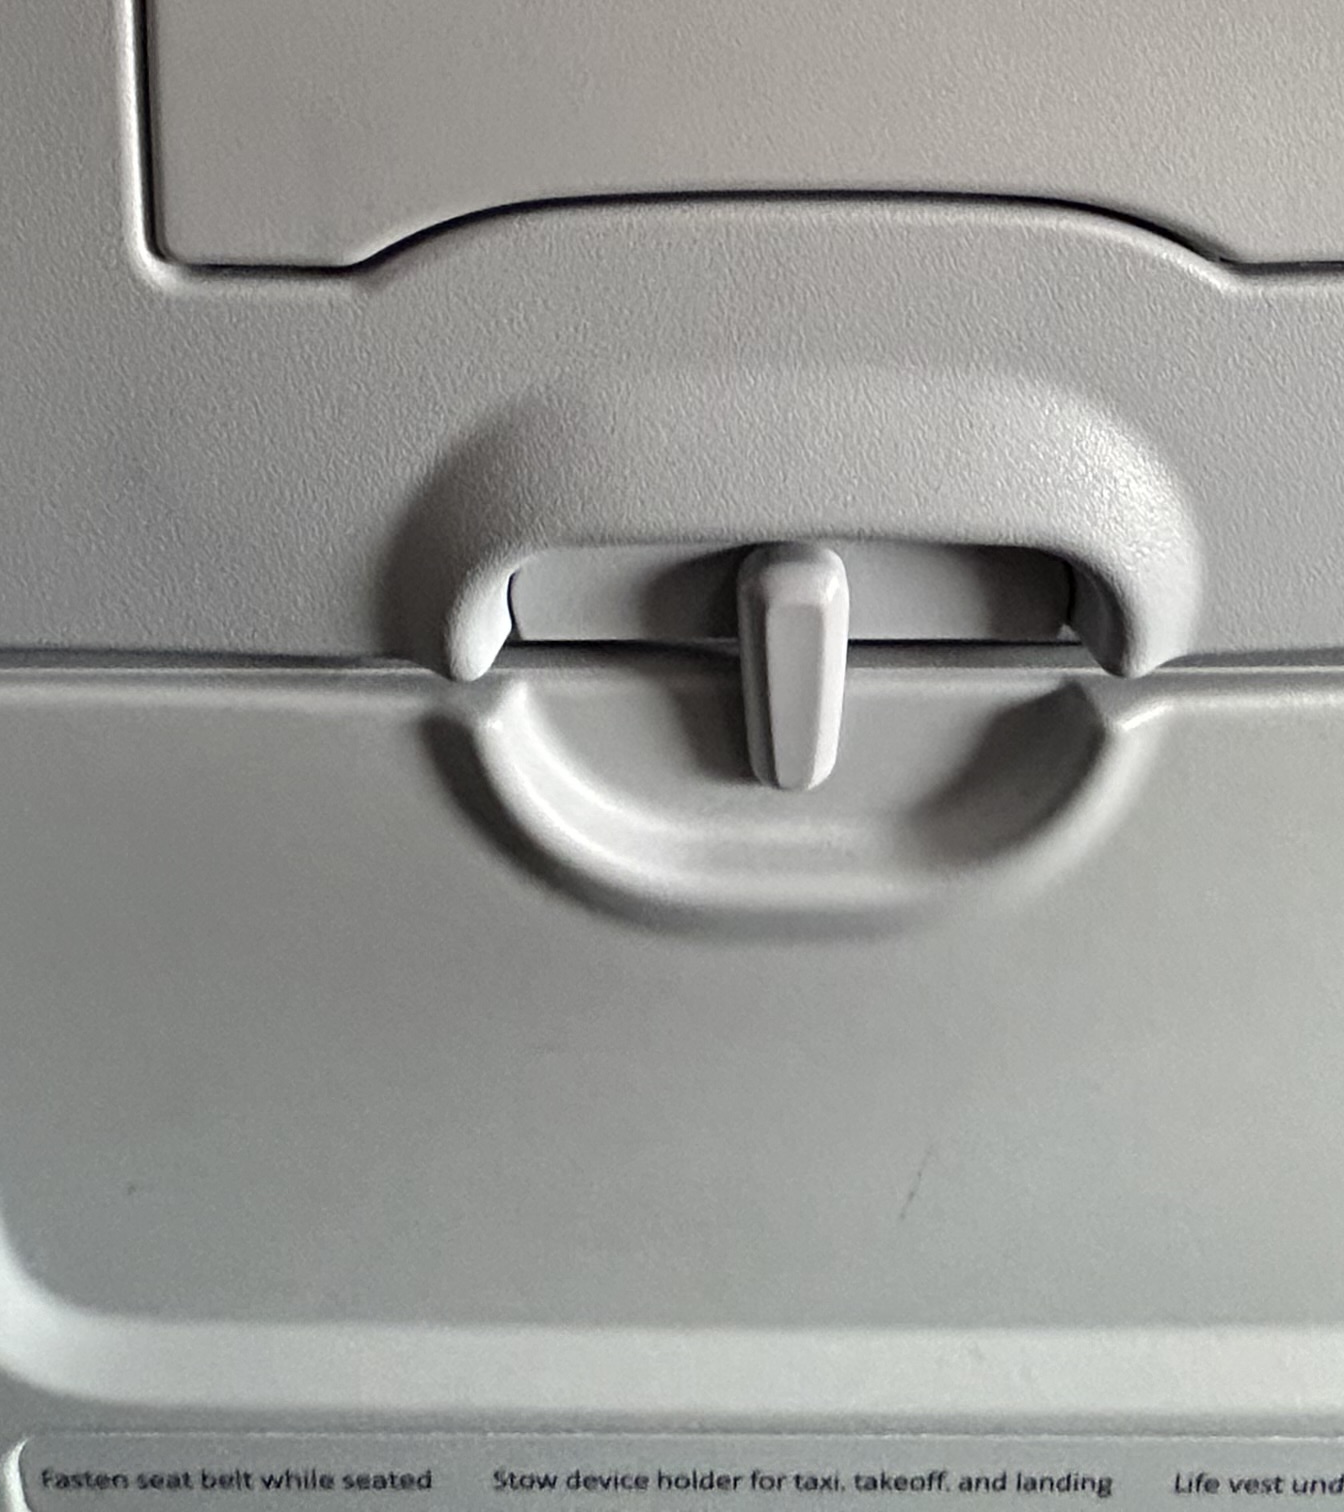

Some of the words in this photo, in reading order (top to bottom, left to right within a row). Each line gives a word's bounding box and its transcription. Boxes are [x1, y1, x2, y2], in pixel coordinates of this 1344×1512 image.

[41, 1469, 129, 1491] Fasten
[136, 1471, 193, 1491] seat
[201, 1469, 253, 1491] belt
[260, 1469, 335, 1491] while
[342, 1470, 432, 1491] seated
[493, 1470, 559, 1492] Stow
[565, 1469, 650, 1492] device
[657, 1469, 744, 1492] holder
[750, 1470, 787, 1492] for
[958, 1471, 1007, 1493] and
[1016, 1471, 1114, 1499] landing
[1173, 1471, 1221, 1495] Life
[1228, 1475, 1286, 1495] vest
